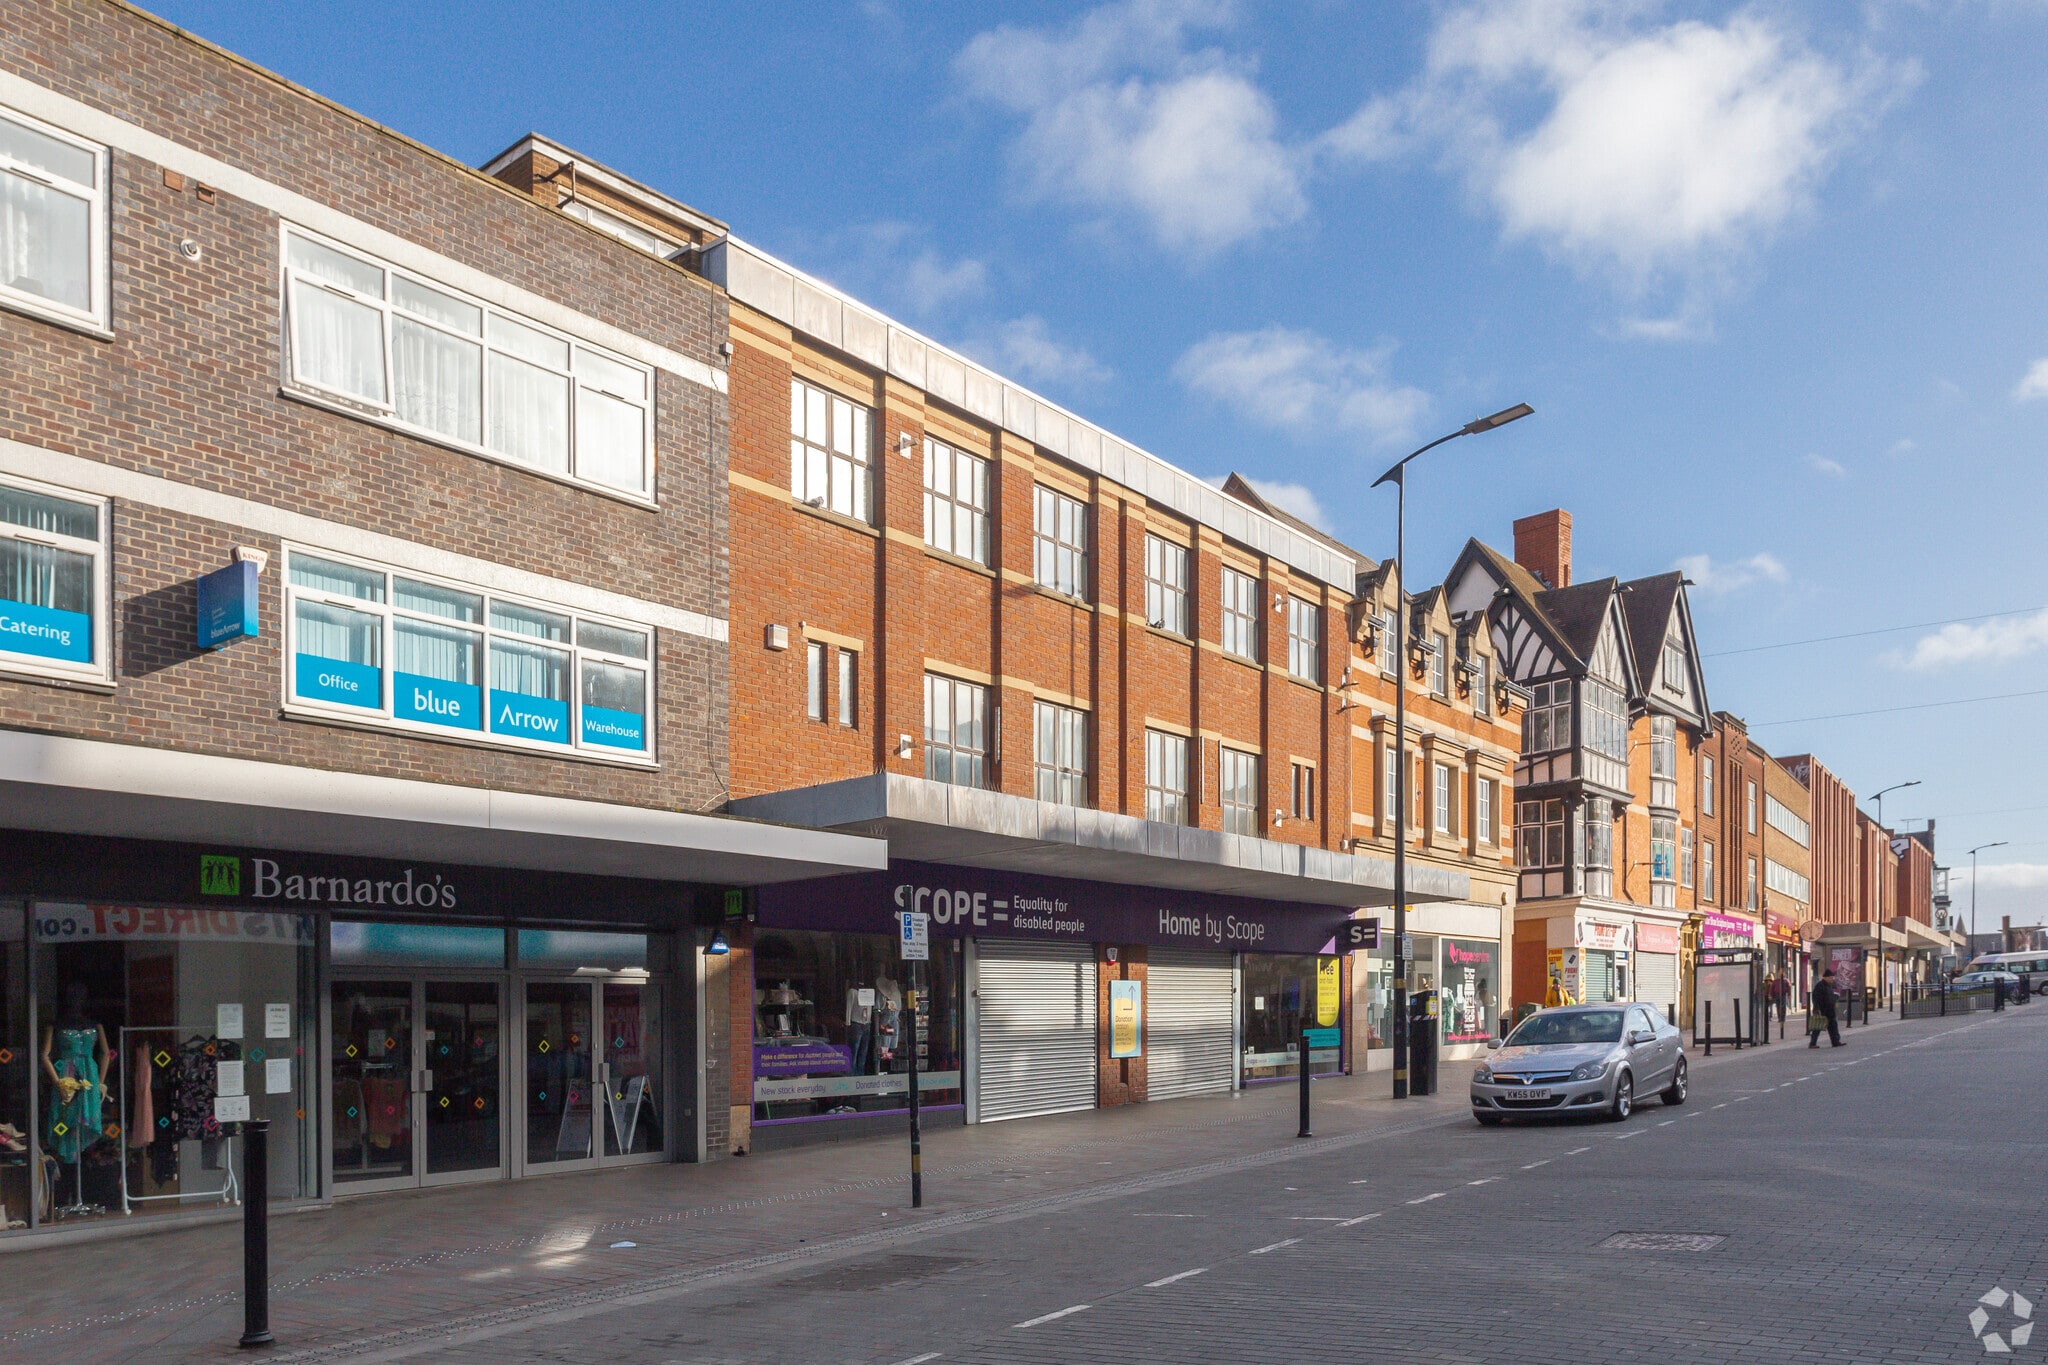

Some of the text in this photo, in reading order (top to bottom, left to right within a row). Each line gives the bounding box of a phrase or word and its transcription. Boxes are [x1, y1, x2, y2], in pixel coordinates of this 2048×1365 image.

[0, 616, 71, 646] Catering
[318, 674, 358, 692] Office
[414, 688, 559, 732] blue Arrow
[586, 720, 640, 738] Warehouse
[252, 858, 456, 908] Barnardo's
[1013, 895, 1068, 914] Equality for
[1013, 914, 1085, 934] disabled people
[1159, 908, 1265, 945] Home by Scope
[1320, 962, 1334, 975] Free
[778, 1086, 794, 1094] stock
[797, 1083, 826, 1095] everyday
[856, 1080, 902, 1089] Donated clothes
[1508, 1090, 1528, 1098] KW55
